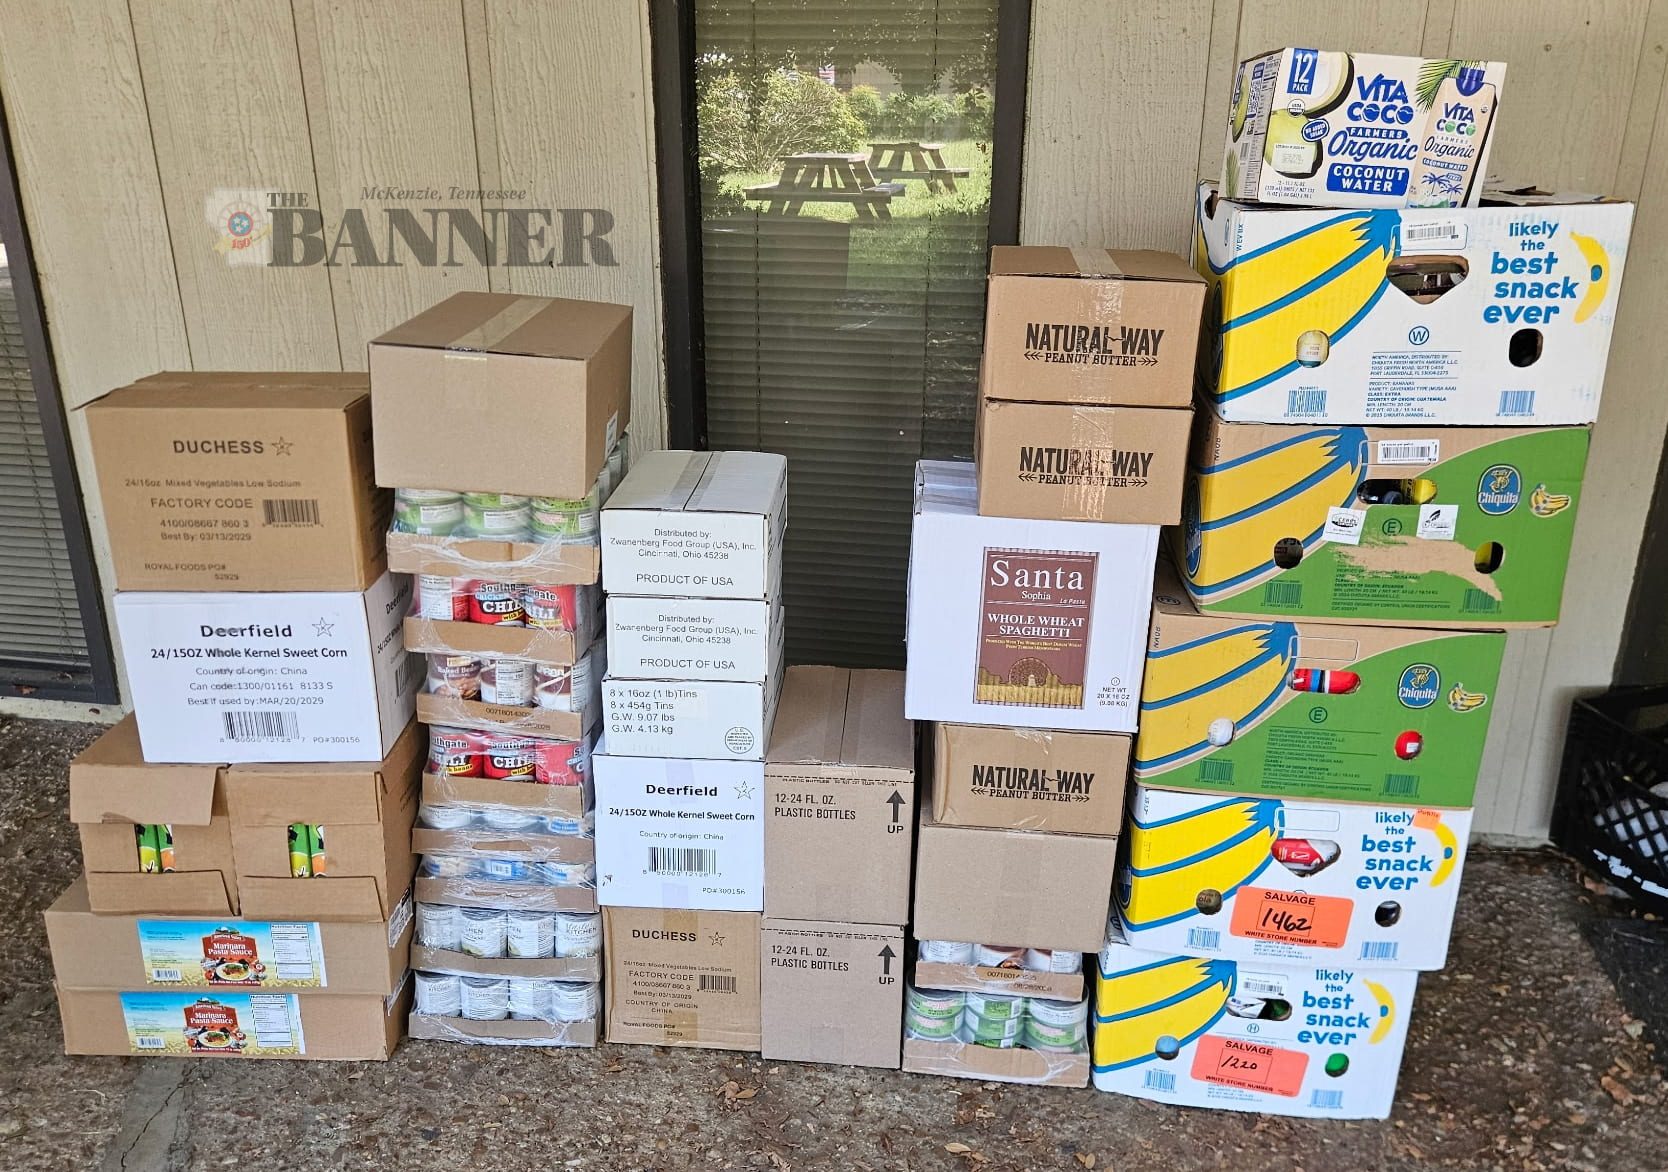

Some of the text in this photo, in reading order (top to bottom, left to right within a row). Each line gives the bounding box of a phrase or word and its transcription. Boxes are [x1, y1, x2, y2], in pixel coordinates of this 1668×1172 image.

[1294, 53, 1314, 84] 12
[1292, 83, 1308, 92] PACK
[1356, 73, 1408, 104] VITA
[1347, 102, 1414, 124] COCO
[1444, 102, 1475, 122] VITA
[1351, 127, 1402, 139] FARMERS
[1436, 118, 1476, 136] COCO
[1328, 131, 1418, 162] Organic
[1424, 136, 1475, 158] Organic
[1424, 158, 1468, 170] COCONUT WATER
[1333, 165, 1406, 180] COCONUT
[1342, 178, 1392, 192] WATER
[1508, 221, 1560, 238] likely
[1520, 240, 1545, 250] the
[1491, 252, 1558, 274] best
[1494, 276, 1579, 298] snack
[1483, 305, 1560, 324] ever
[1026, 323, 1165, 356] NATURAL WAY
[1045, 352, 1137, 366] PEANUT BUTTER
[173, 440, 264, 454] DUCHESS
[1020, 447, 1154, 478] NATURAL WAY
[165, 479, 301, 488] Mixed Vegetables Low Sodium
[1038, 474, 1082, 484] PEANUT
[150, 498, 254, 508] FACTORY CODE
[1478, 490, 1519, 506] Chiquita
[160, 532, 198, 542] Best By:
[654, 528, 712, 538] Distributed by:
[610, 538, 757, 550] Zwanenberg Food Group (USA), Inc.
[704, 552, 728, 560] 45238
[636, 574, 734, 586] PRODUCT OF USA
[990, 560, 1084, 590] Santa
[1021, 590, 1051, 602] Sophia
[658, 614, 715, 624] Distributed by:
[988, 613, 1085, 626] WHOLE WHEAT
[200, 624, 292, 638] Deerfield
[666, 624, 686, 632] Food
[688, 626, 713, 634] Group
[715, 626, 741, 636] (USA),
[1000, 625, 1070, 638] SPAGHETTI
[706, 636, 731, 644] 45238
[151, 648, 348, 660] 24/15OZ Whole Kernel Sweet Corn
[640, 658, 736, 670] PRODUCT OF USA
[196, 667, 233, 678] Country
[280, 667, 308, 676] China
[190, 682, 334, 691] Can 8133 S
[1398, 686, 1437, 700] Chiquita
[627, 690, 651, 698] 16oz
[218, 696, 242, 706] used
[627, 702, 651, 711] 454g
[654, 702, 674, 710] Tins
[612, 713, 635, 721] G.W.
[638, 713, 658, 721] 9.07
[612, 725, 674, 734] G.W. 4.13 kg
[972, 765, 1095, 794] NATURAL WAY
[646, 784, 718, 797] Deerfield
[988, 788, 1071, 802] PEANUT BUTTER
[776, 793, 836, 805] 12-24 FL. OZ.
[609, 808, 755, 820] 24/15OZ Whole Kernel Sweet Corn
[774, 808, 856, 820] PLASTIC BOTTLES
[1375, 812, 1414, 826] likely
[640, 830, 668, 840] Country
[887, 825, 904, 834] UP
[1385, 826, 1405, 835] the
[1362, 834, 1416, 852] best
[1365, 855, 1434, 872] snack
[1356, 876, 1418, 890] ever
[1264, 892, 1316, 906] SALVAGE
[1261, 908, 1312, 932] 1462
[632, 930, 697, 942] DUCHESS
[1244, 930, 1318, 945] WRITE STORE NUMBER
[771, 945, 830, 957] 12-24 FL. OZ.
[771, 958, 848, 971] PLASTIC BOTTLES
[628, 970, 694, 981] FACTORY CODE
[878, 976, 895, 985] UP
[1316, 970, 1354, 984] likely
[1325, 984, 1344, 992] the
[1303, 991, 1354, 1010] best
[1306, 1012, 1371, 1028] snack
[1298, 1030, 1358, 1045] ever
[1224, 1040, 1274, 1056] SALVAGE
[1206, 1075, 1274, 1092] WRITE STORE NUMBER
